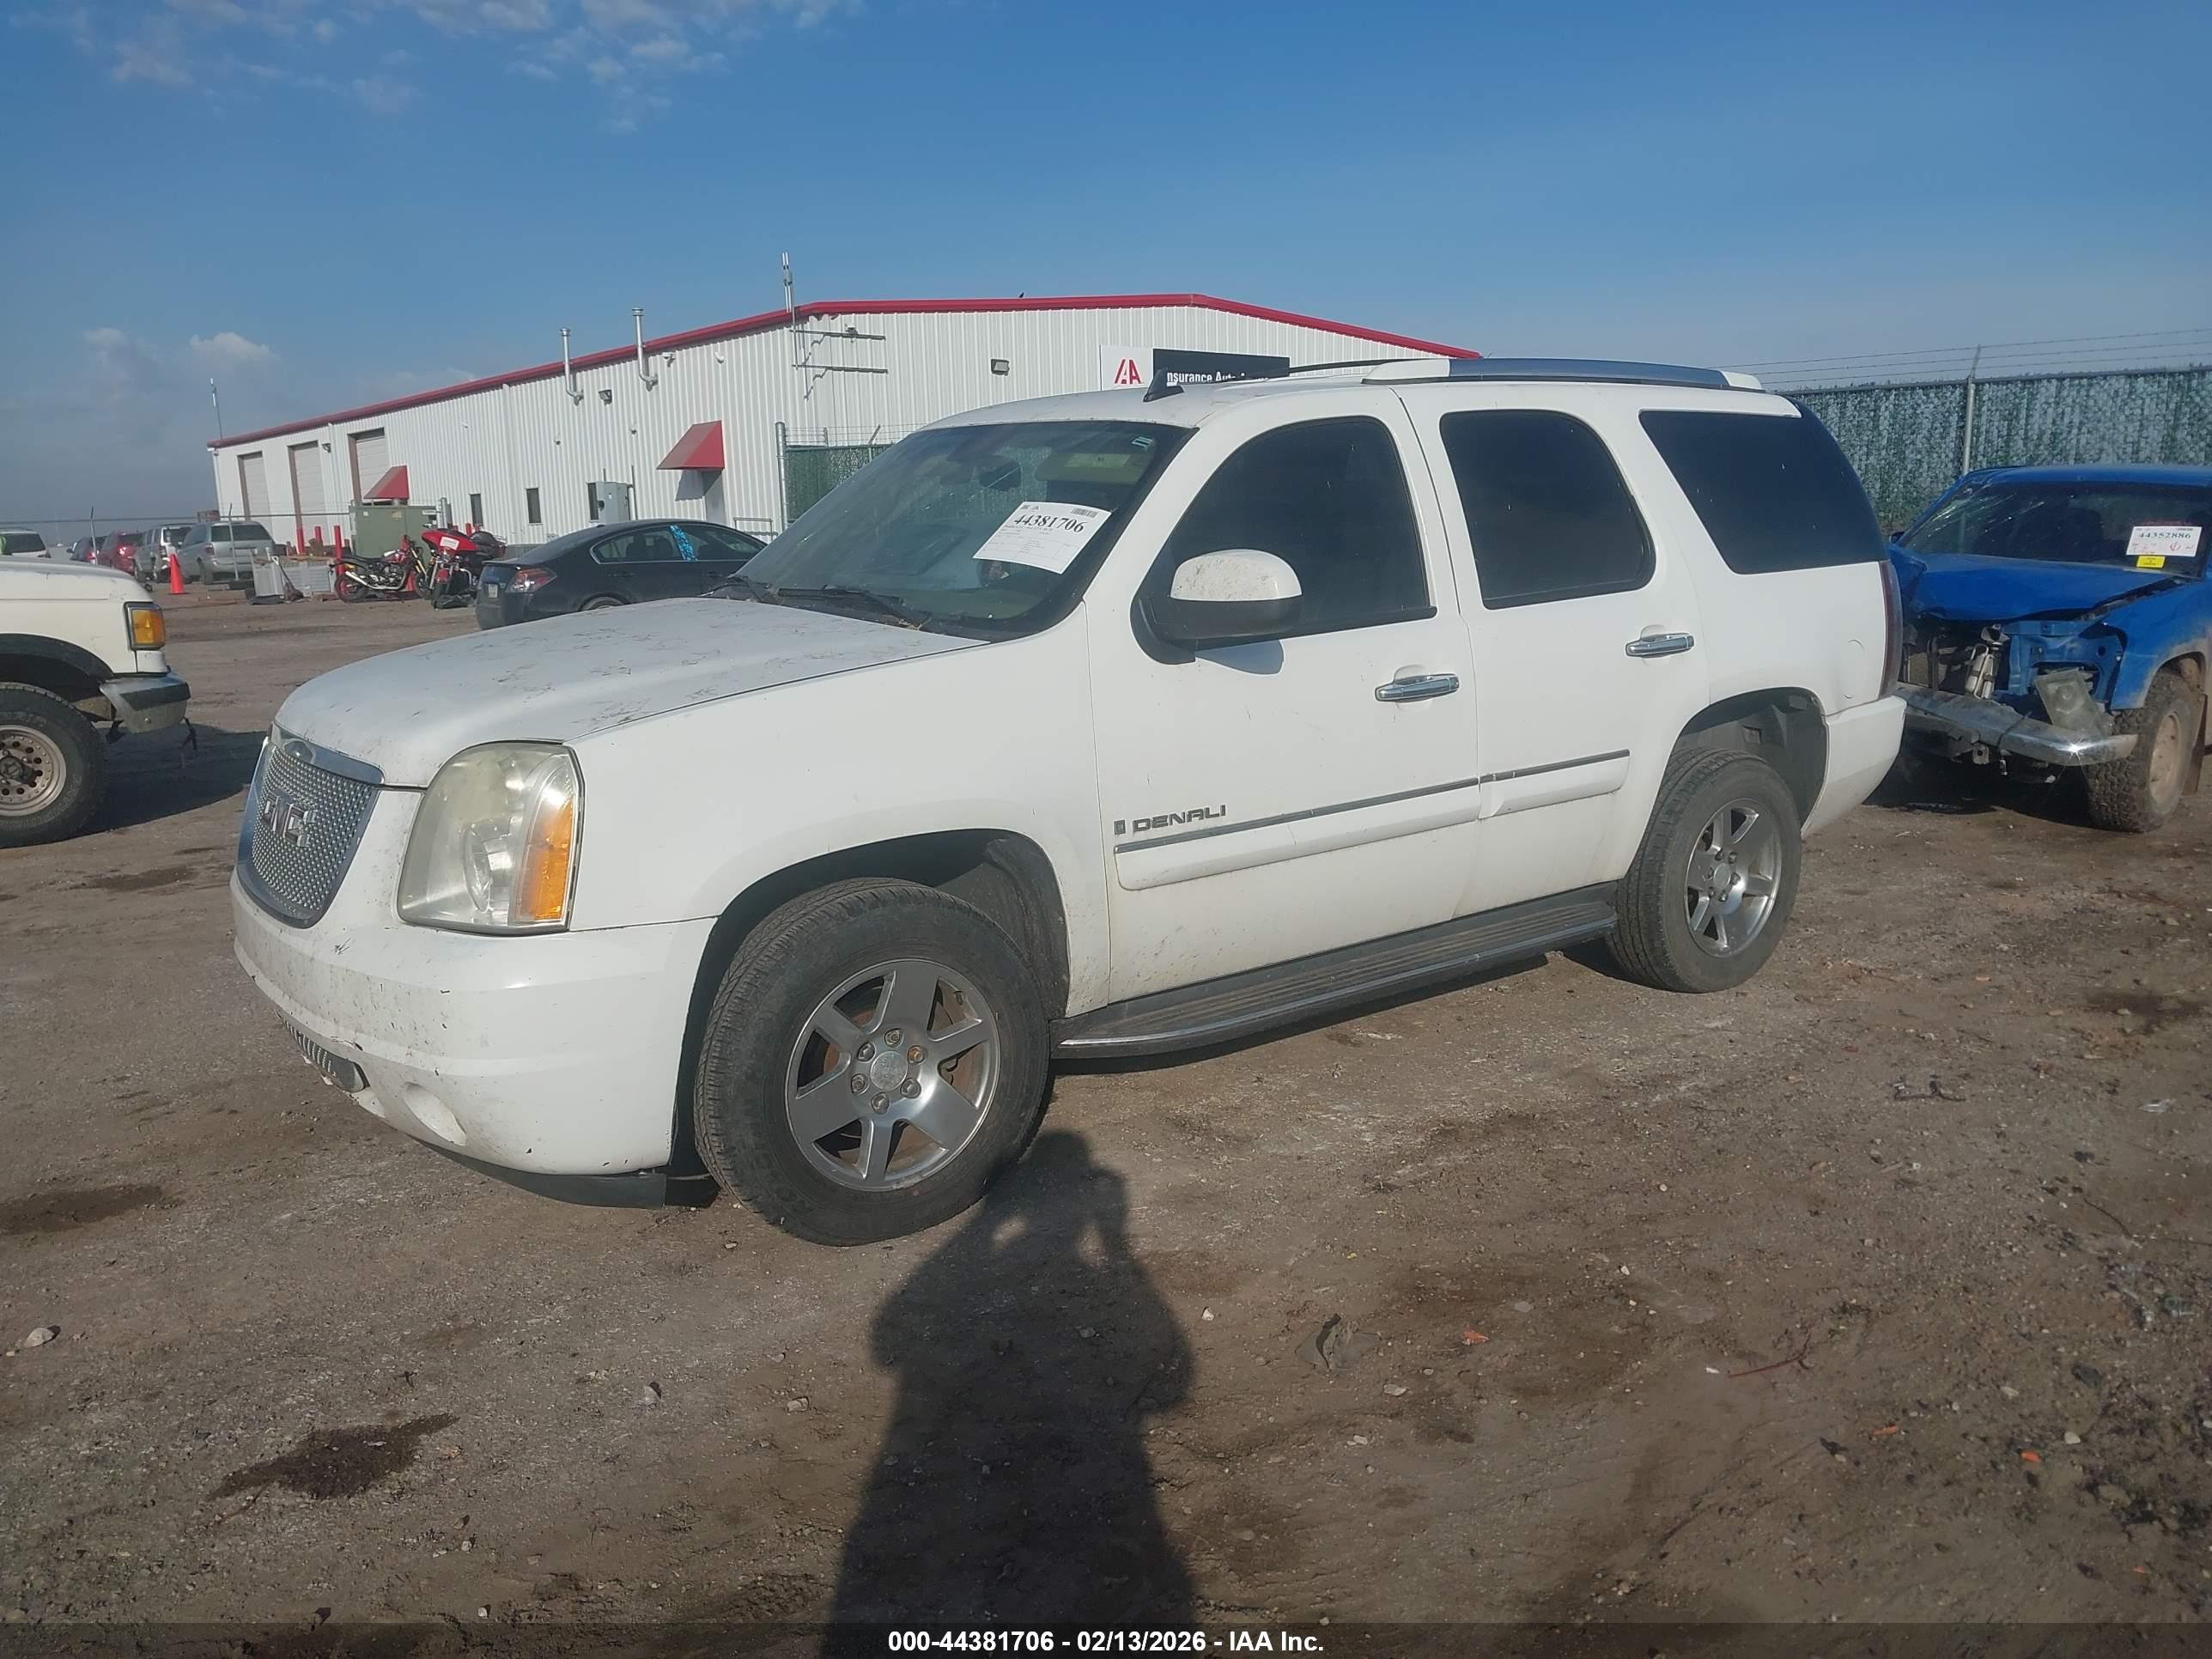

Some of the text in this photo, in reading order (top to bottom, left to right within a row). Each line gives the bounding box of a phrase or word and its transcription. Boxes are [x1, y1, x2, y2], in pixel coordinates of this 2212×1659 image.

[1167, 371, 1212, 383] nsurance
[1014, 514, 1089, 533] 44381706
[1133, 805, 1226, 833] DENALI
